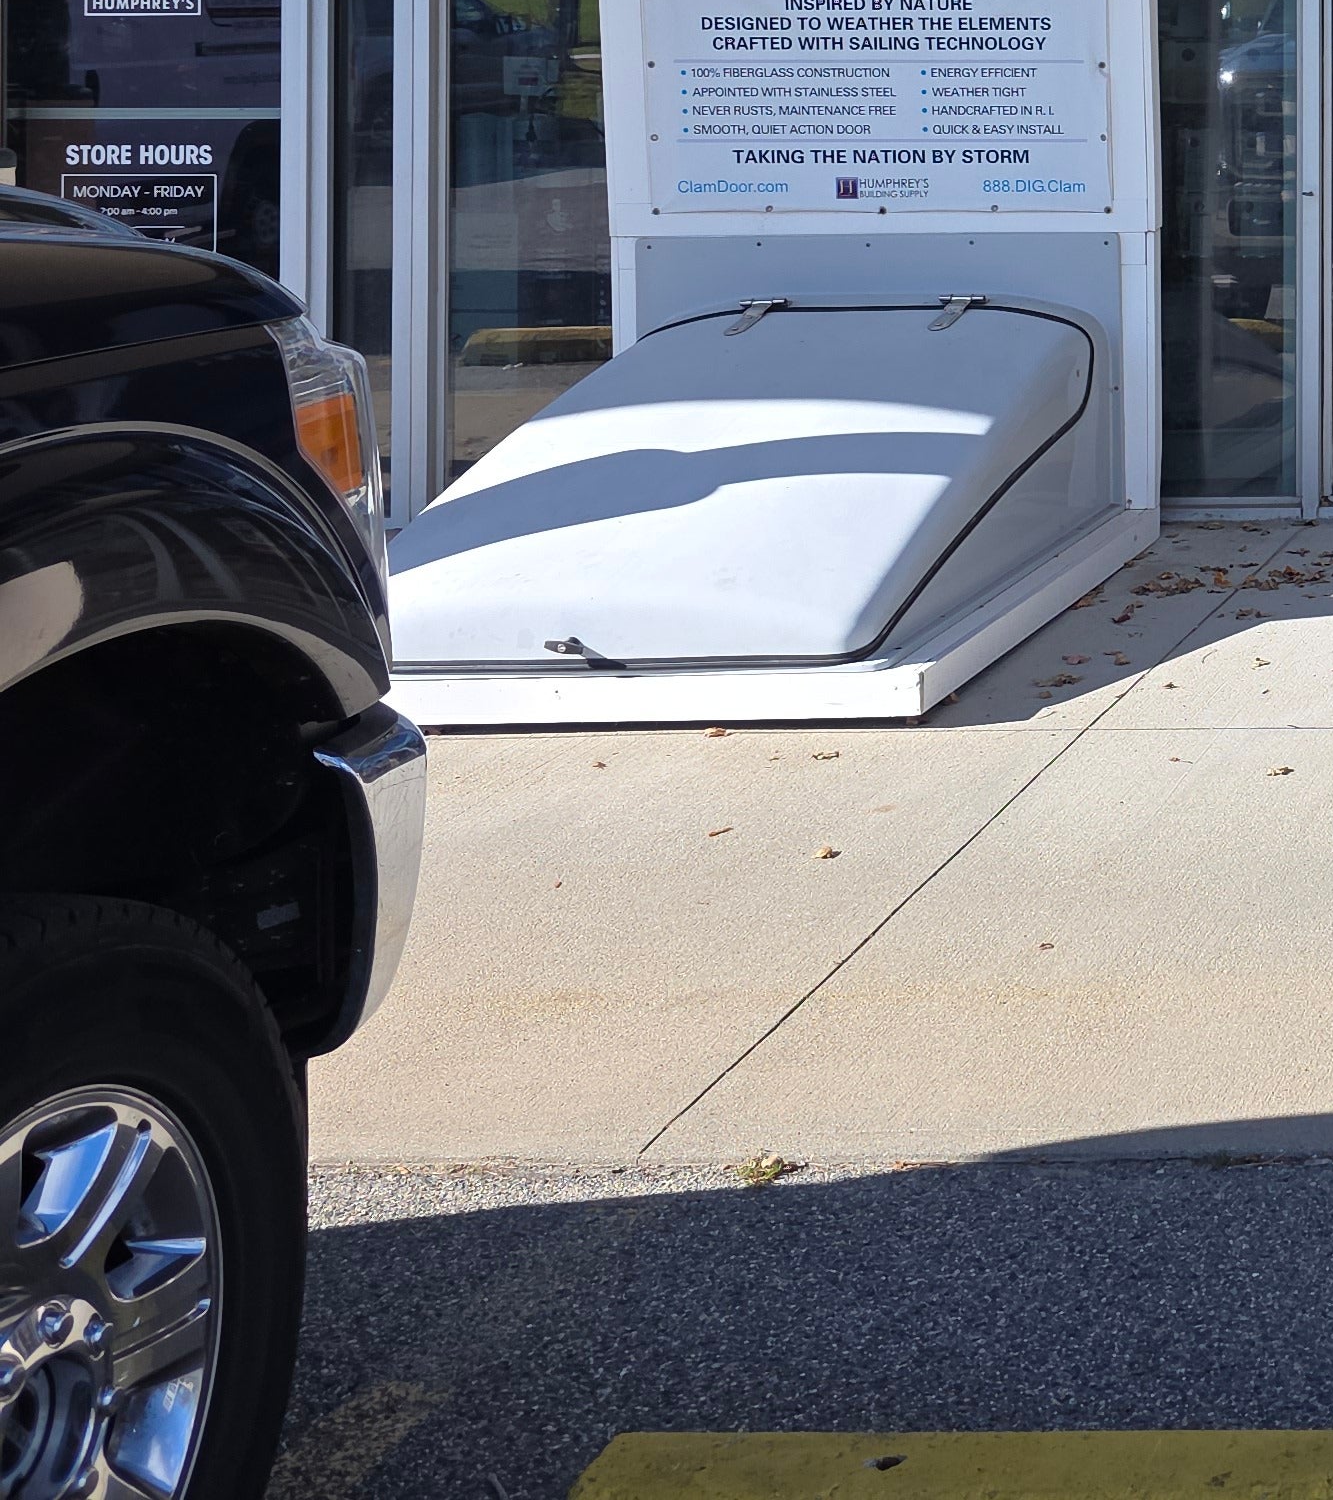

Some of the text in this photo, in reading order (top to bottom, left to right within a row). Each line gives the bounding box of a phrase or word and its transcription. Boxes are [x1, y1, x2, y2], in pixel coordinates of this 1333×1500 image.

[701, 17, 1052, 31] DESIGNED TO WEATHER THE ELEMENTS
[713, 36, 1046, 50] CRAFTED WITH SAILING TECHNOLOGY
[691, 68, 890, 78] 100% FIBERGLASS CONSTRUCTION
[930, 68, 1038, 78] ENERGY EFFICIENT
[692, 87, 897, 97] APPOINTED WITH STAINLESS STEEL
[932, 87, 1026, 97] WEATHER TIGHT
[692, 106, 897, 117] NEVER RUSTS, MAINTENANCE FREE
[932, 106, 1018, 116] HANDCRAFTED
[1020, 106, 1033, 116] IN
[693, 125, 871, 136] SMOOTH, QUIET ACTION DOOR
[932, 125, 1064, 136] QUICK & EASY INSTALL
[65, 144, 213, 166] STORE HOURS
[733, 149, 1030, 164] TAKING THE NATION BY STORM
[677, 180, 789, 193] ClamDoor.com
[859, 178, 929, 189] HUMPHREY'S
[982, 180, 1086, 193] 888.DIG.Clam
[73, 185, 141, 198] MONDAY
[153, 185, 205, 198] FRIDAY
[859, 190, 928, 198] BUILDING SUPPLY
